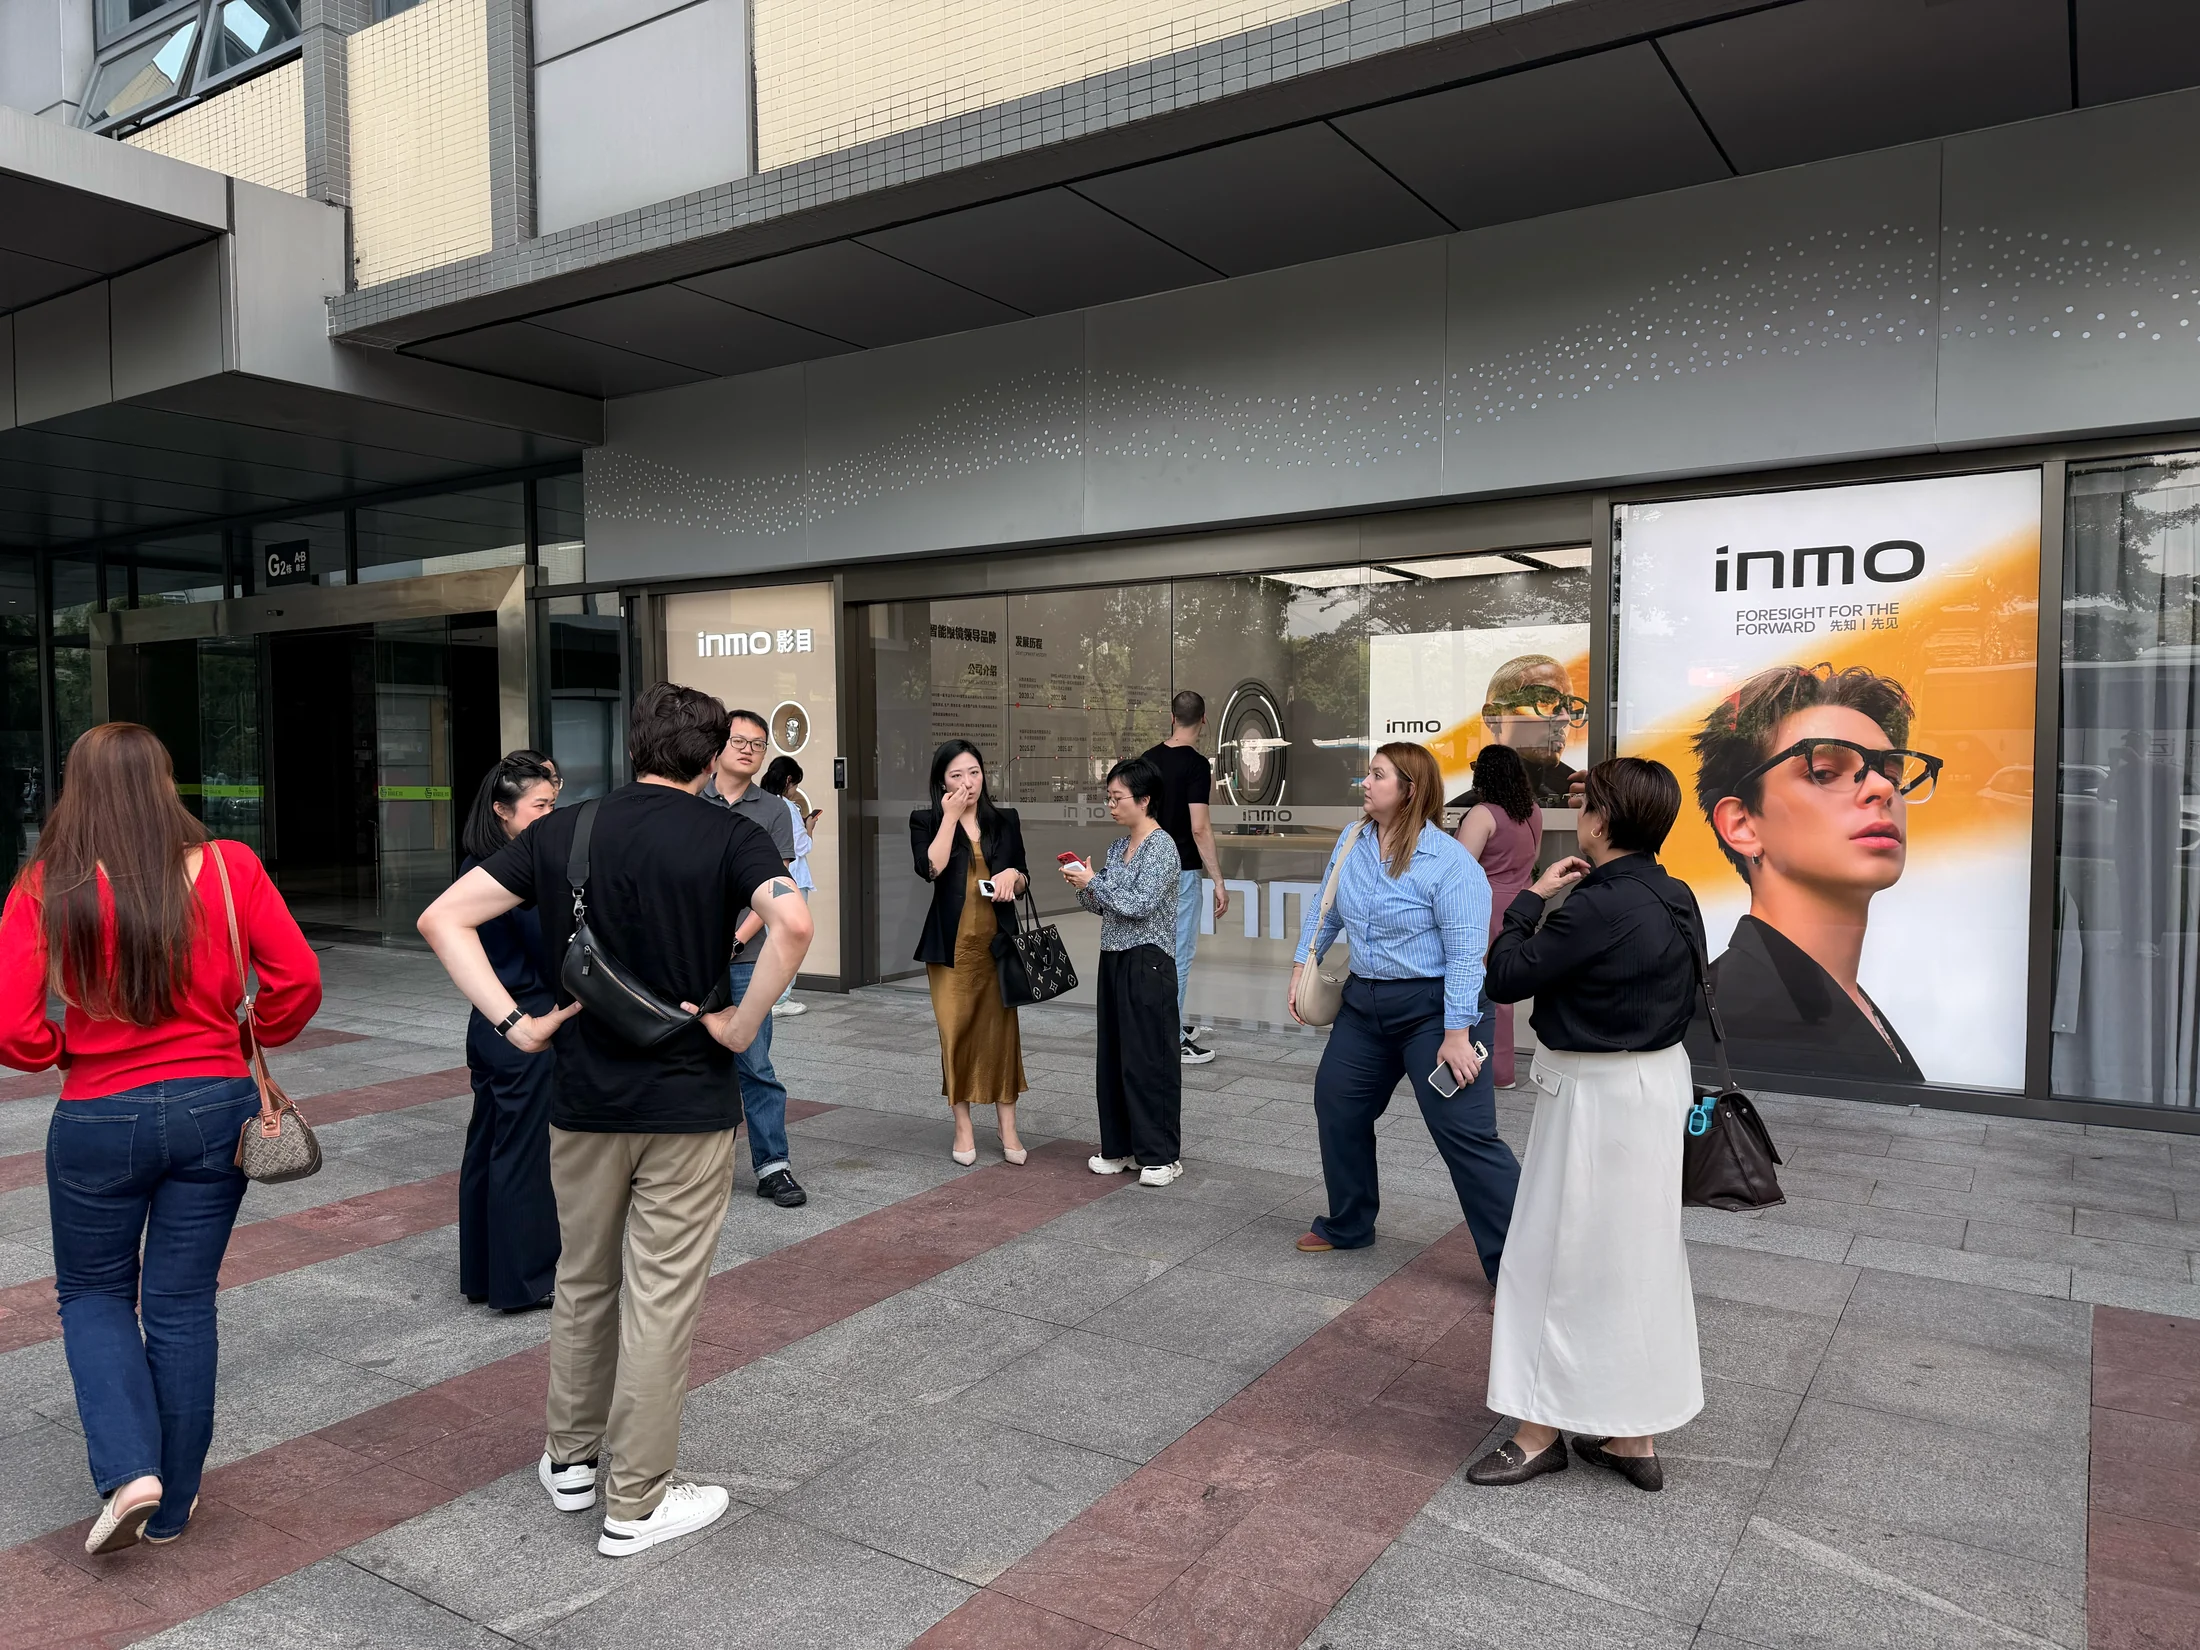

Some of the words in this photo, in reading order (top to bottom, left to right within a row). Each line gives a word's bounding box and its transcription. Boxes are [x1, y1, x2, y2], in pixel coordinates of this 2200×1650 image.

[1715, 539, 1926, 592] inmo
[1735, 605, 1825, 622] FORESIGHT
[1828, 604, 1863, 617] FOR
[1867, 602, 1900, 616] THE
[1735, 620, 1816, 636] FORWARD
[697, 631, 772, 657] inmo
[776, 628, 814, 654] 影目
[1015, 635, 1043, 650] 发展历程
[968, 663, 997, 677] 公司介绍
[1385, 718, 1441, 734] inmo
[1242, 808, 1292, 822] inmo
[1200, 878, 1348, 944] nm
